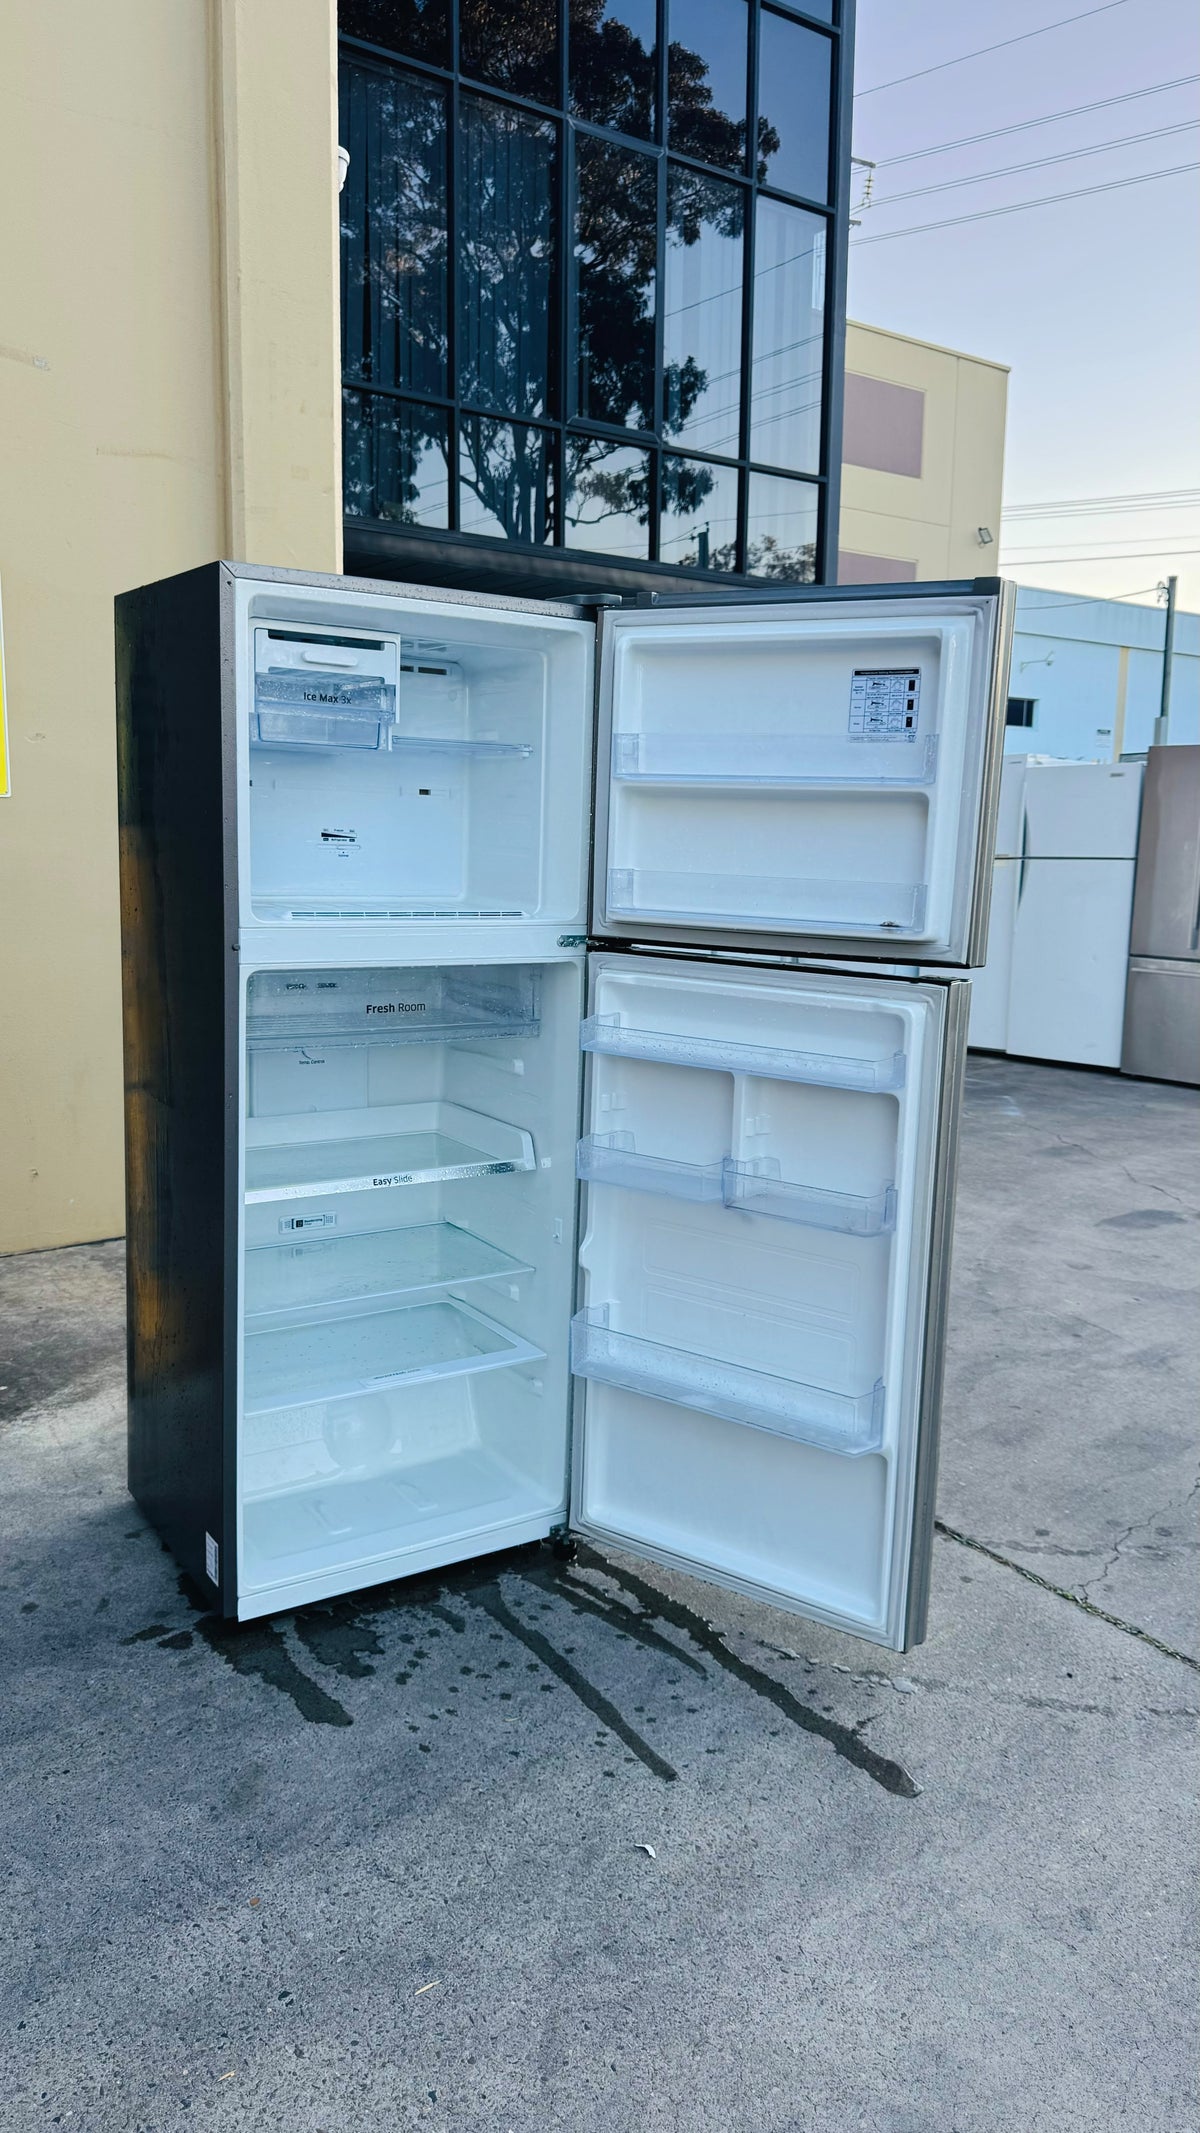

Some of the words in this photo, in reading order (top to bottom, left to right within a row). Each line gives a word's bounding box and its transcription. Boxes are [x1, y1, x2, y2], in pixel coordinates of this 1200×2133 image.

[303, 691, 317, 701] Ice
[319, 693, 339, 704] Max
[341, 695, 352, 705] 3x
[366, 1003, 396, 1014] Fresh
[398, 1002, 426, 1012] Room
[372, 1177, 392, 1187] Easy
[393, 1174, 413, 1184] Slide
